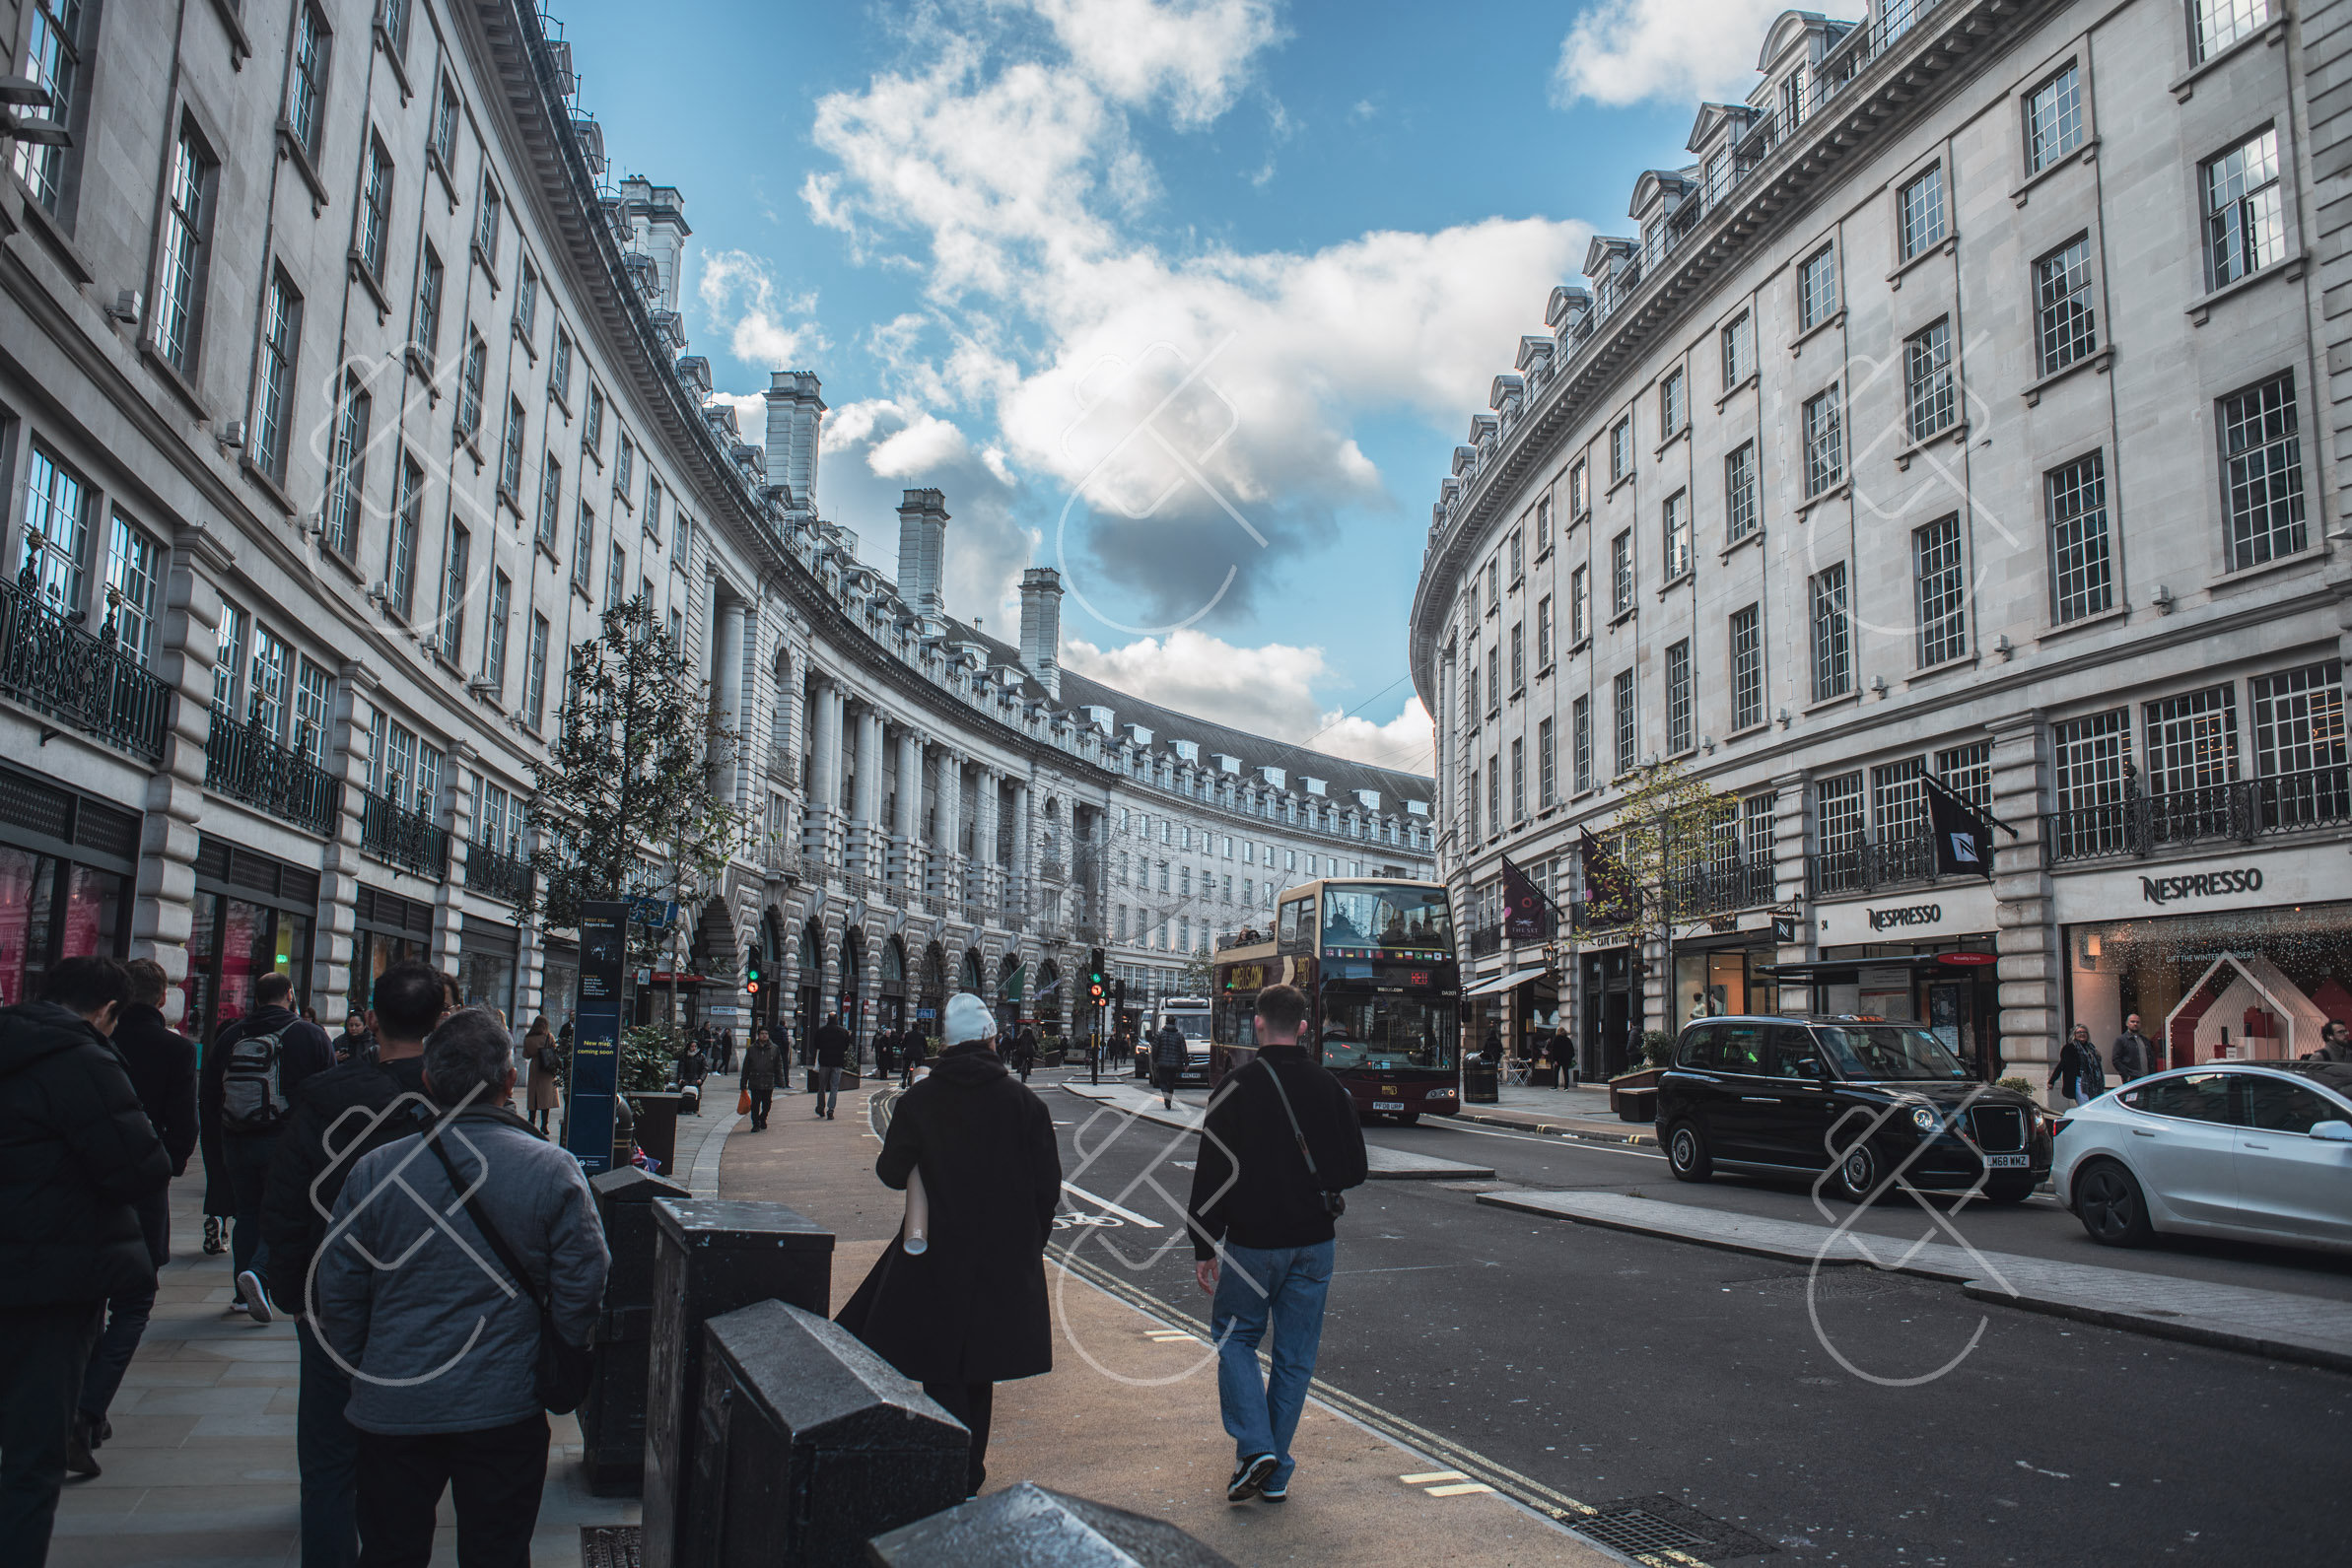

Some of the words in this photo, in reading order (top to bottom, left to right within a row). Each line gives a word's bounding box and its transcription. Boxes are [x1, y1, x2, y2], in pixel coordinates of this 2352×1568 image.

[2138, 868, 2263, 906] NESPRESSO
[1776, 920, 1792, 938] N
[1866, 904, 1942, 932] NESPRESSO
[1986, 1156, 2008, 1167] LM68
[2009, 1156, 2026, 1166] WMZ
